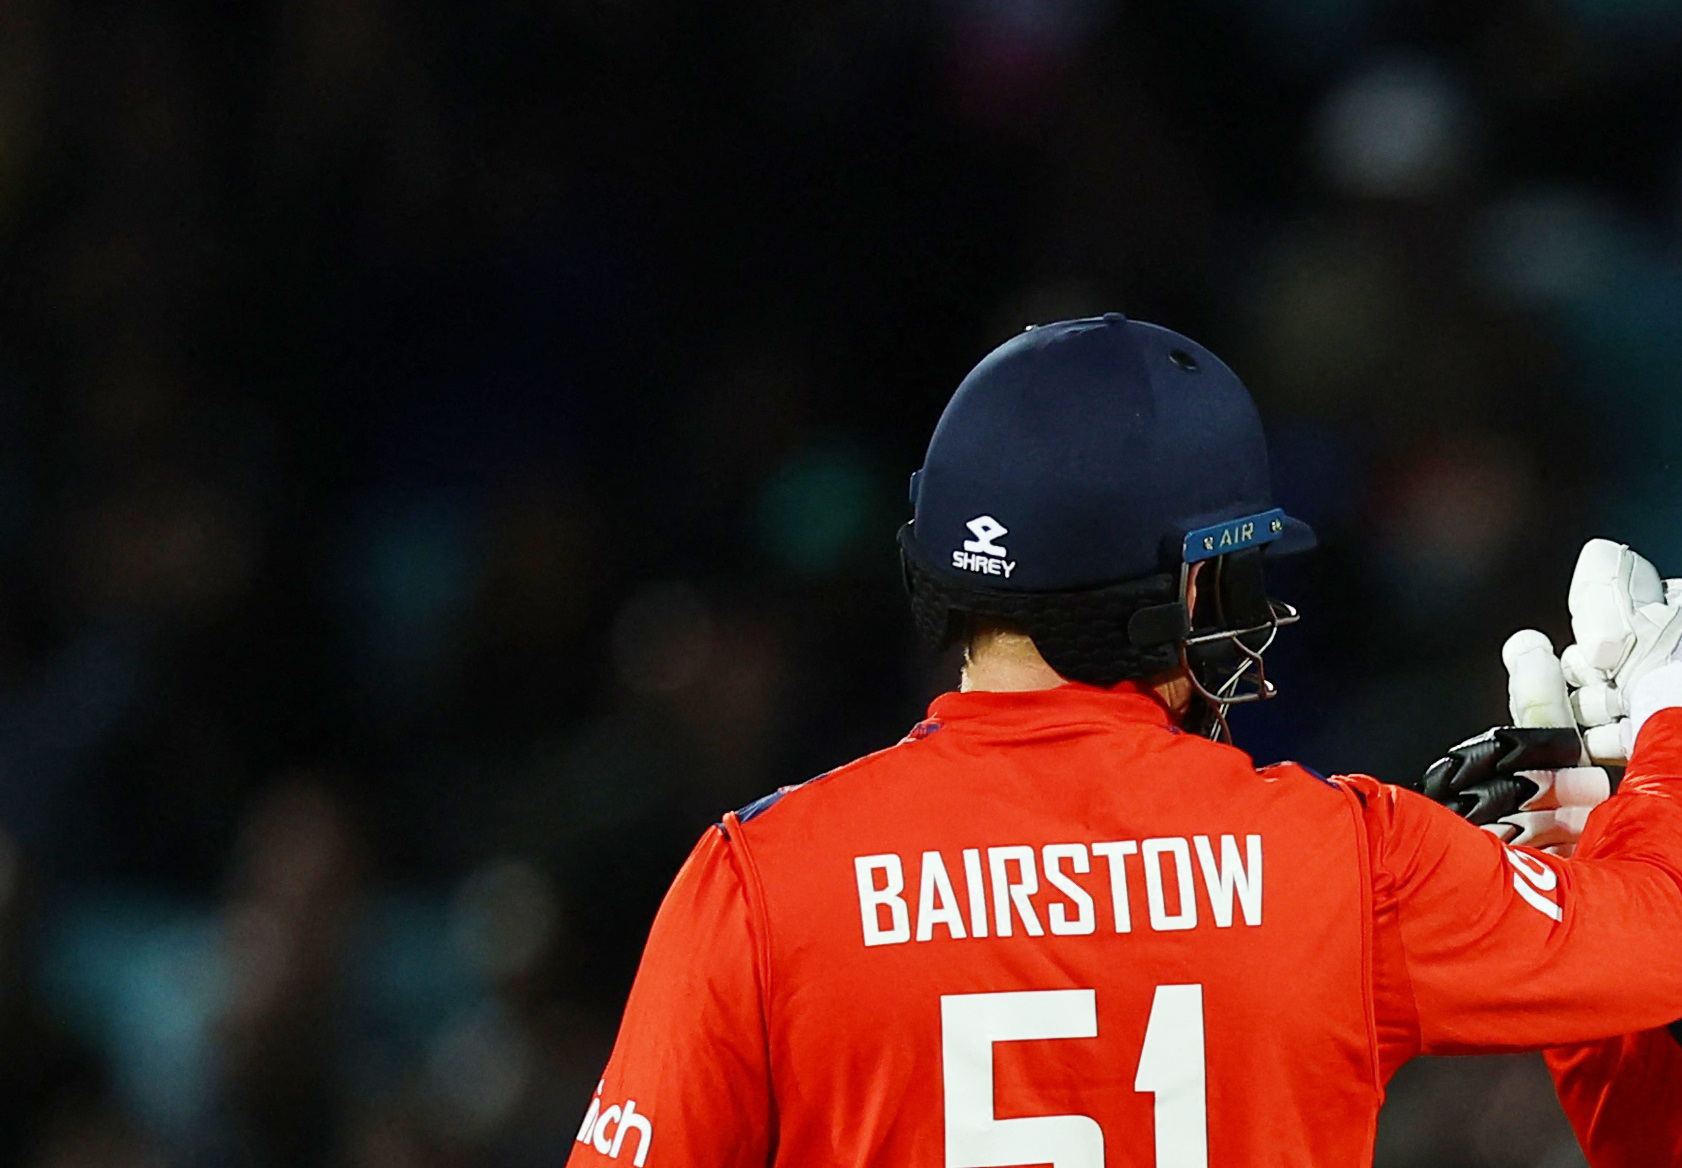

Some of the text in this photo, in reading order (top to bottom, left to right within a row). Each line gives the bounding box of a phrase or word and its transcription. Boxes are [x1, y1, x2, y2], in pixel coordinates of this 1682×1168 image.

[1219, 522, 1254, 548] AIR
[952, 550, 1016, 579] SHREY
[854, 834, 1263, 947] BAIRSTOW
